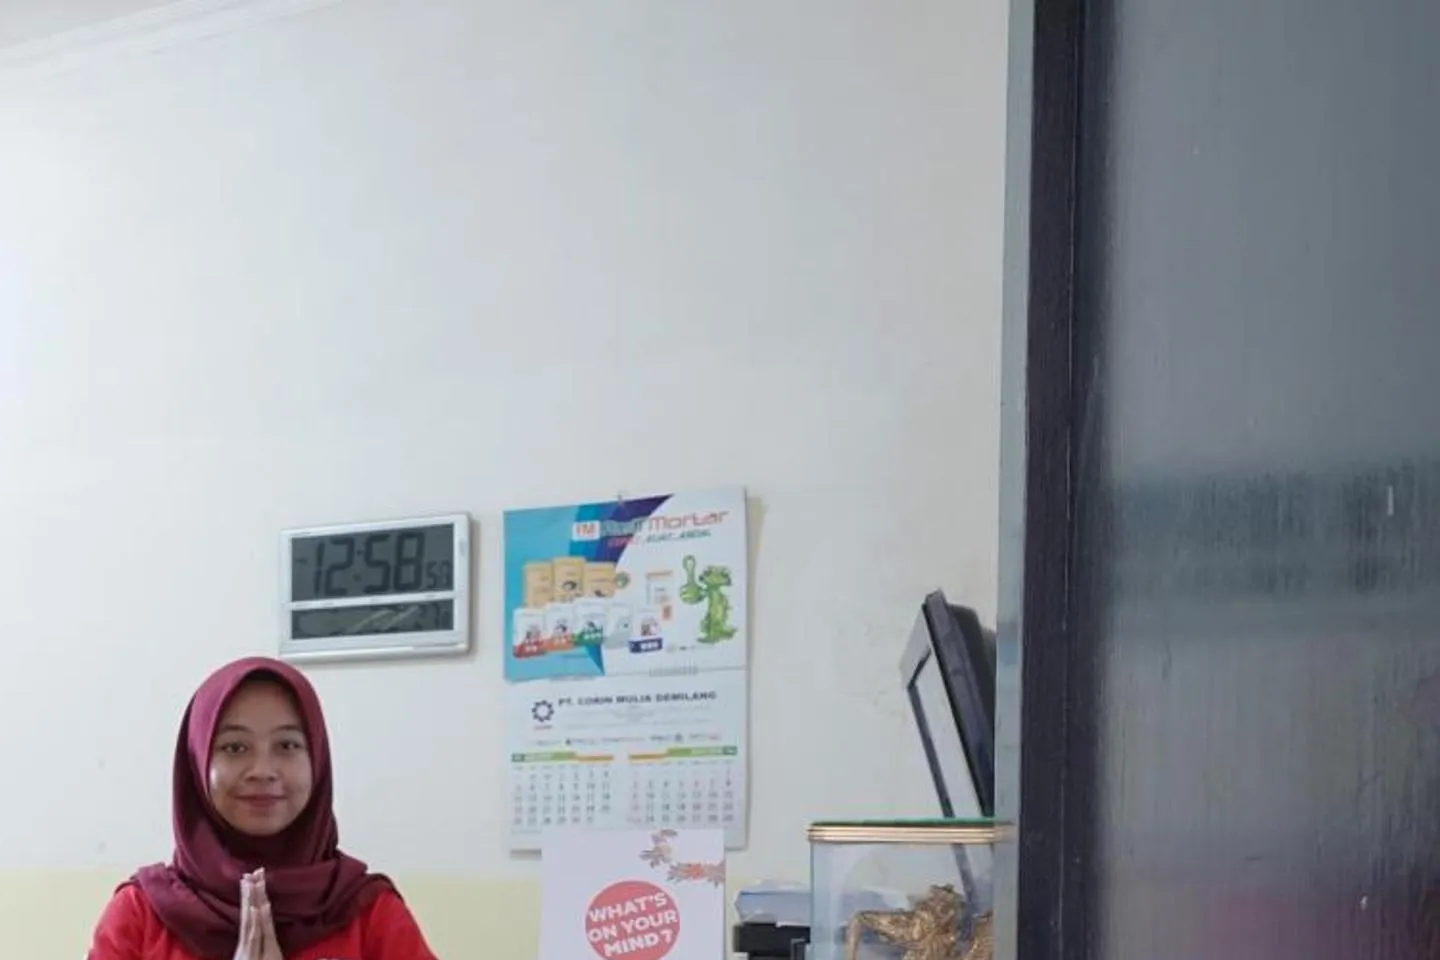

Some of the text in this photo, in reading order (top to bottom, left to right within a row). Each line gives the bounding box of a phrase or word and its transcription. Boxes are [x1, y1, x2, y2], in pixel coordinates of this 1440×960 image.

[313, 532, 425, 597] 12:58
[588, 892, 667, 922] WHAT'S
[588, 909, 677, 942] ON YOUR
